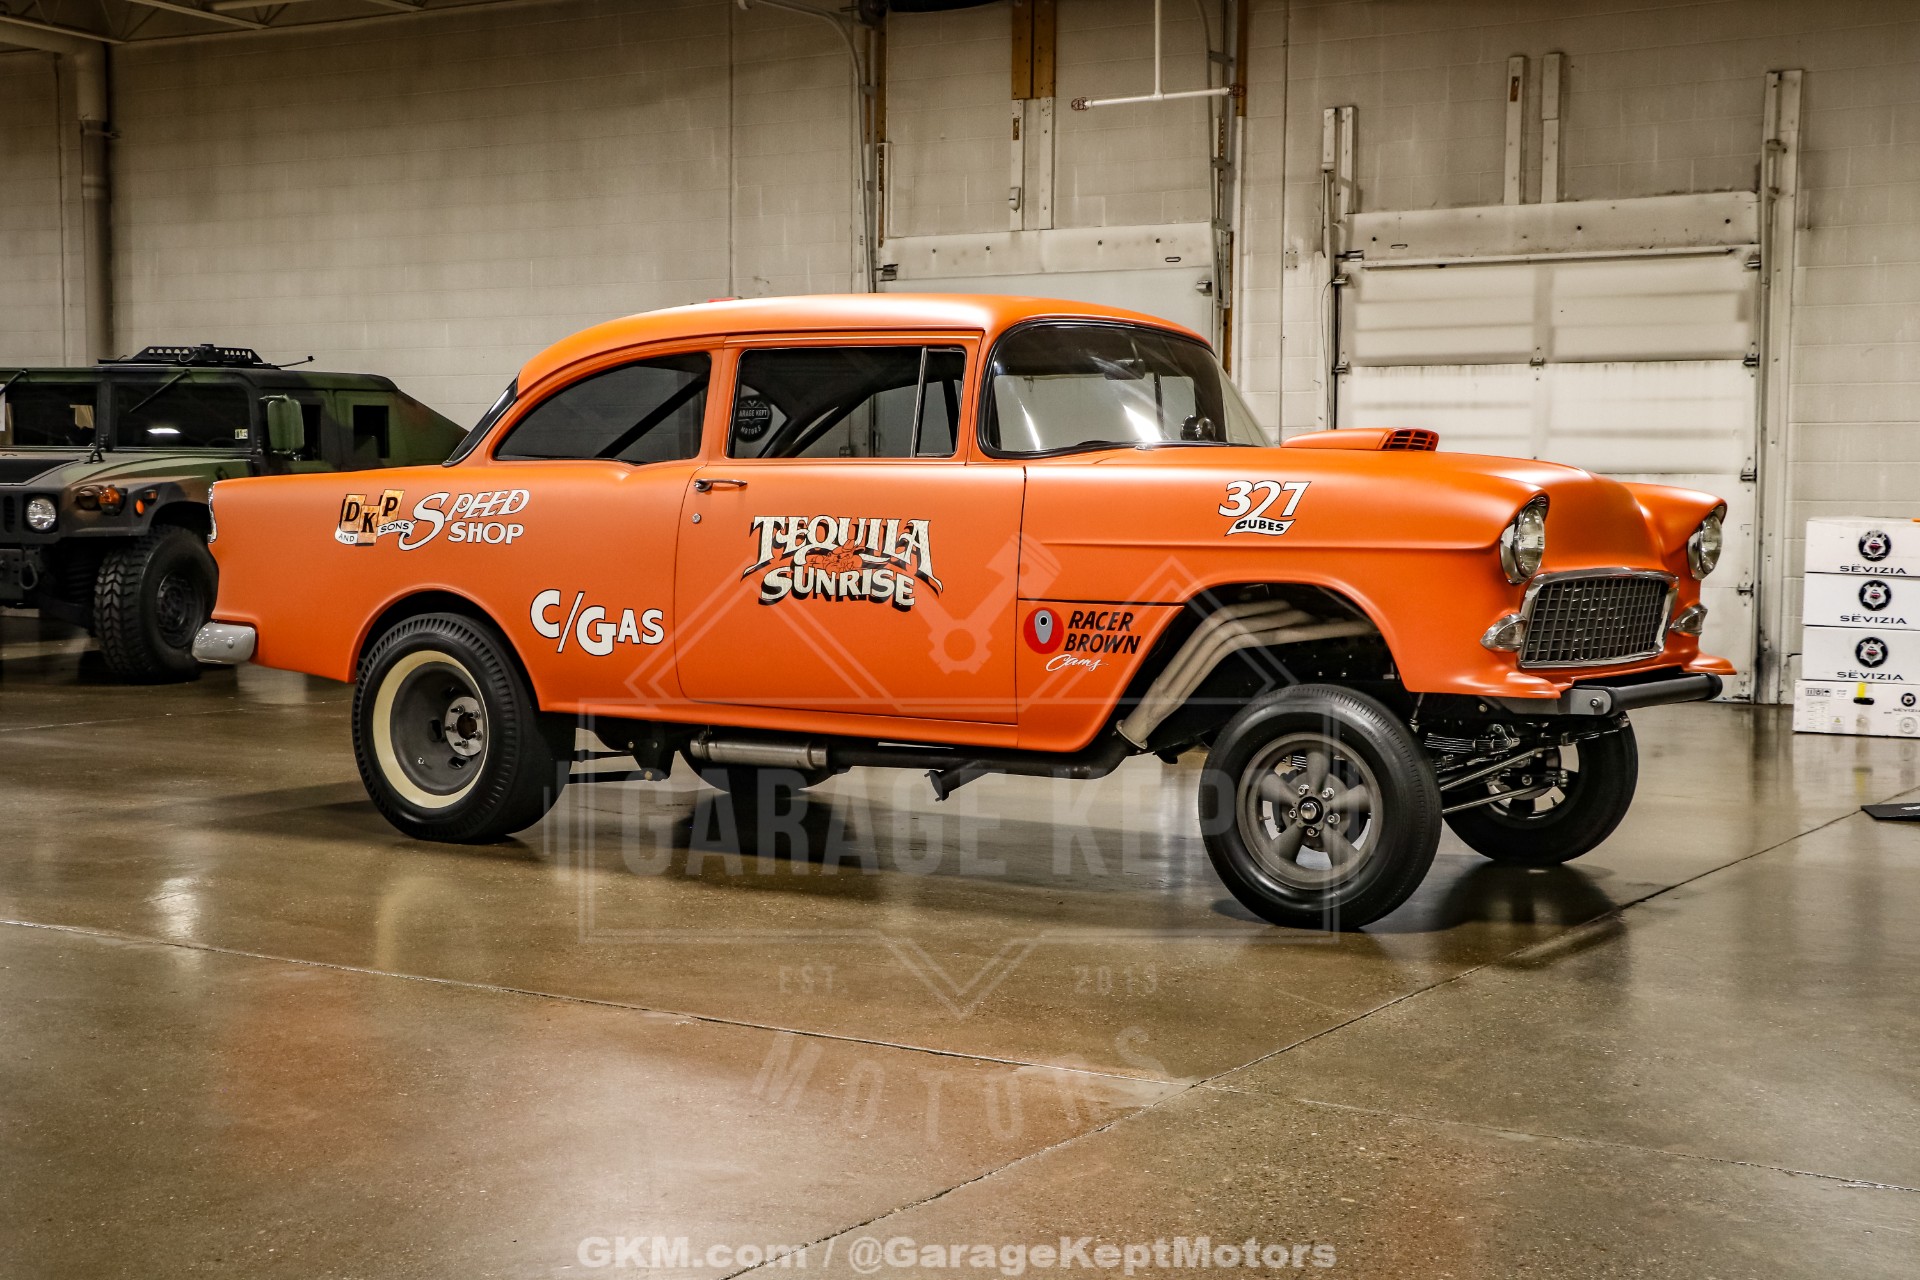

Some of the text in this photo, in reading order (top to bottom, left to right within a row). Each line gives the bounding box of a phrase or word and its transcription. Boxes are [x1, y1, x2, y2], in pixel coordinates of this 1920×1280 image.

[738, 409, 755, 417] ARAGE
[740, 425, 762, 435] MOTORS
[1218, 480, 1311, 517] 327
[398, 489, 530, 551] SPEED
[1235, 519, 1284, 532] CUBES
[338, 522, 410, 542] AND SONS
[447, 521, 524, 545] SHOP
[741, 515, 943, 596] TEQUILA
[758, 566, 916, 612] SUNRISE
[530, 588, 664, 656] C/GAS
[1067, 610, 1134, 632] RACER
[1064, 633, 1141, 654] BROWN
[1045, 653, 1109, 672] Cams
